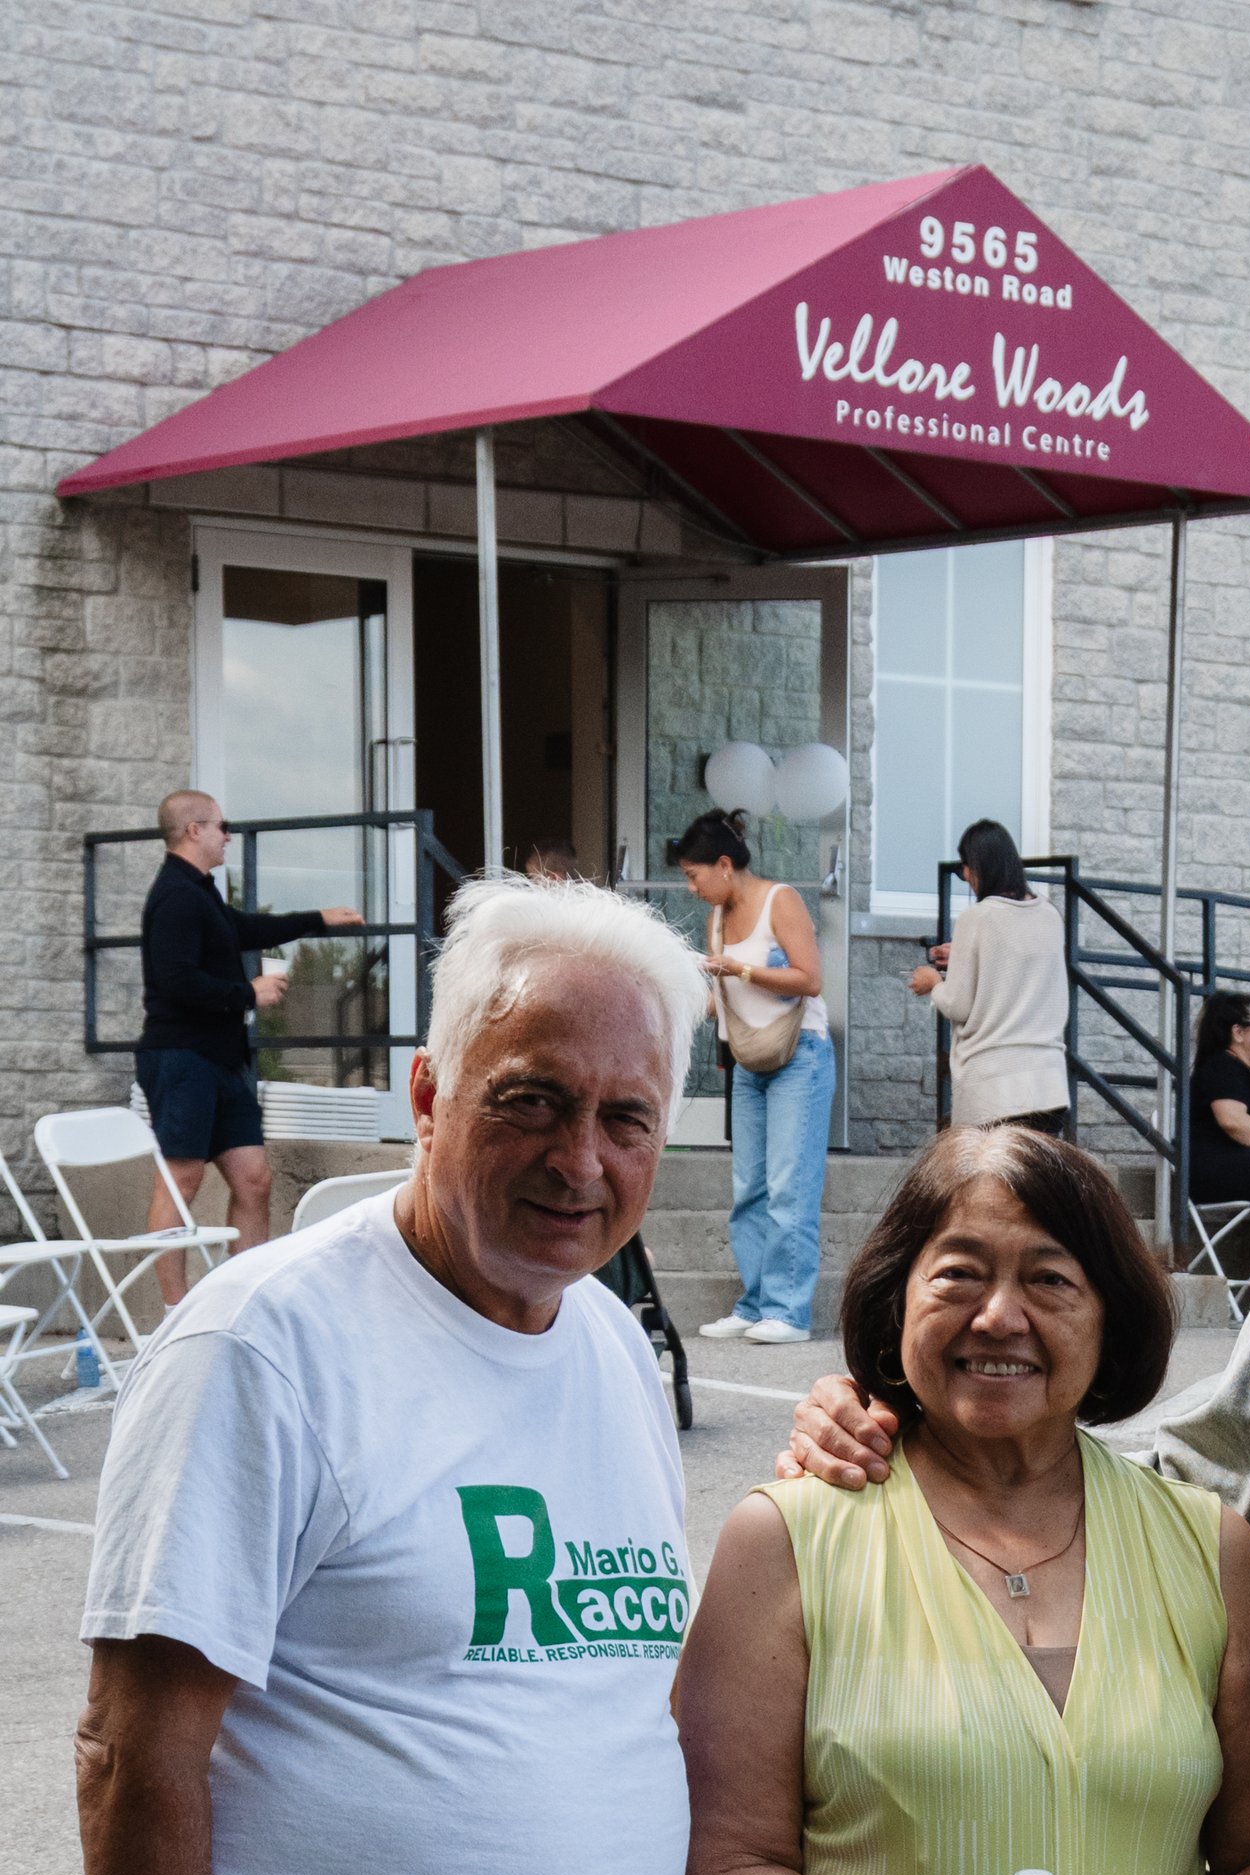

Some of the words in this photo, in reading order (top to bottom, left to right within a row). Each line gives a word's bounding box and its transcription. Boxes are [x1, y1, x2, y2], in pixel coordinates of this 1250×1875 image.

[919, 216, 1039, 273] 9565
[883, 255, 989, 297] Weston
[1002, 275, 1072, 309] Road
[795, 301, 976, 400] Vellore
[992, 331, 1149, 430] Woods
[836, 400, 1011, 446] Professional
[1022, 426, 1111, 461] Centre
[564, 1537, 657, 1577] Mario
[463, 1646, 543, 1662] RELIABLE.
[547, 1643, 642, 1661] RESPONSIBLE.
